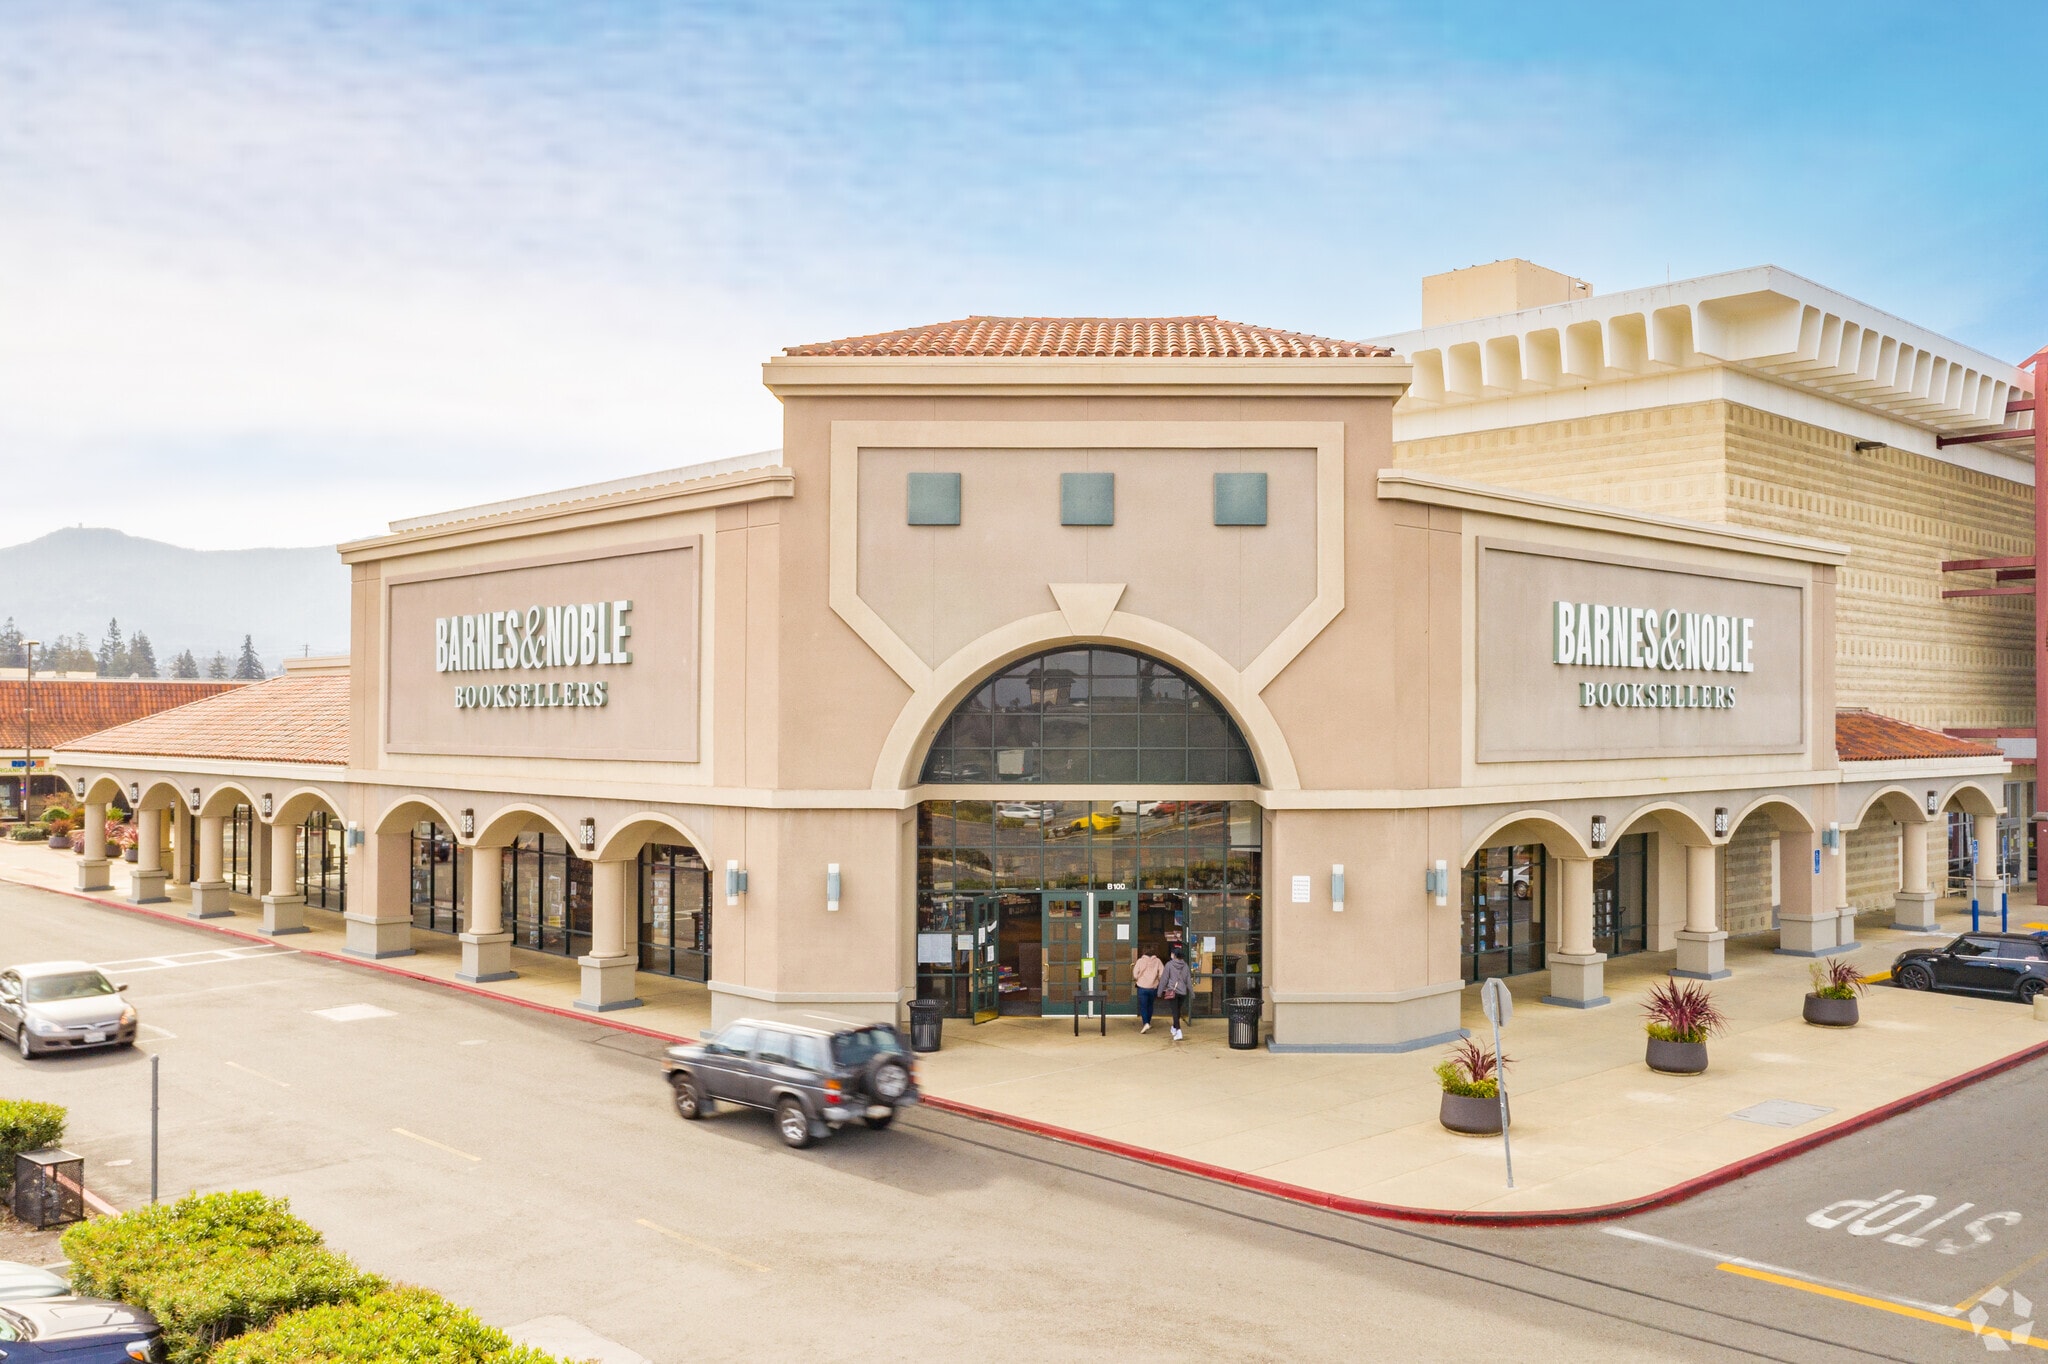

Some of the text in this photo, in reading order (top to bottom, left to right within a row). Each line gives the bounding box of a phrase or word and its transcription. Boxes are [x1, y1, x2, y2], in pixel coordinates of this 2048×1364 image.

[454, 681, 608, 708] BOOKSELLERS
[1579, 683, 1736, 708] BOOKSELLERS
[1806, 1189, 2022, 1254] STOP
